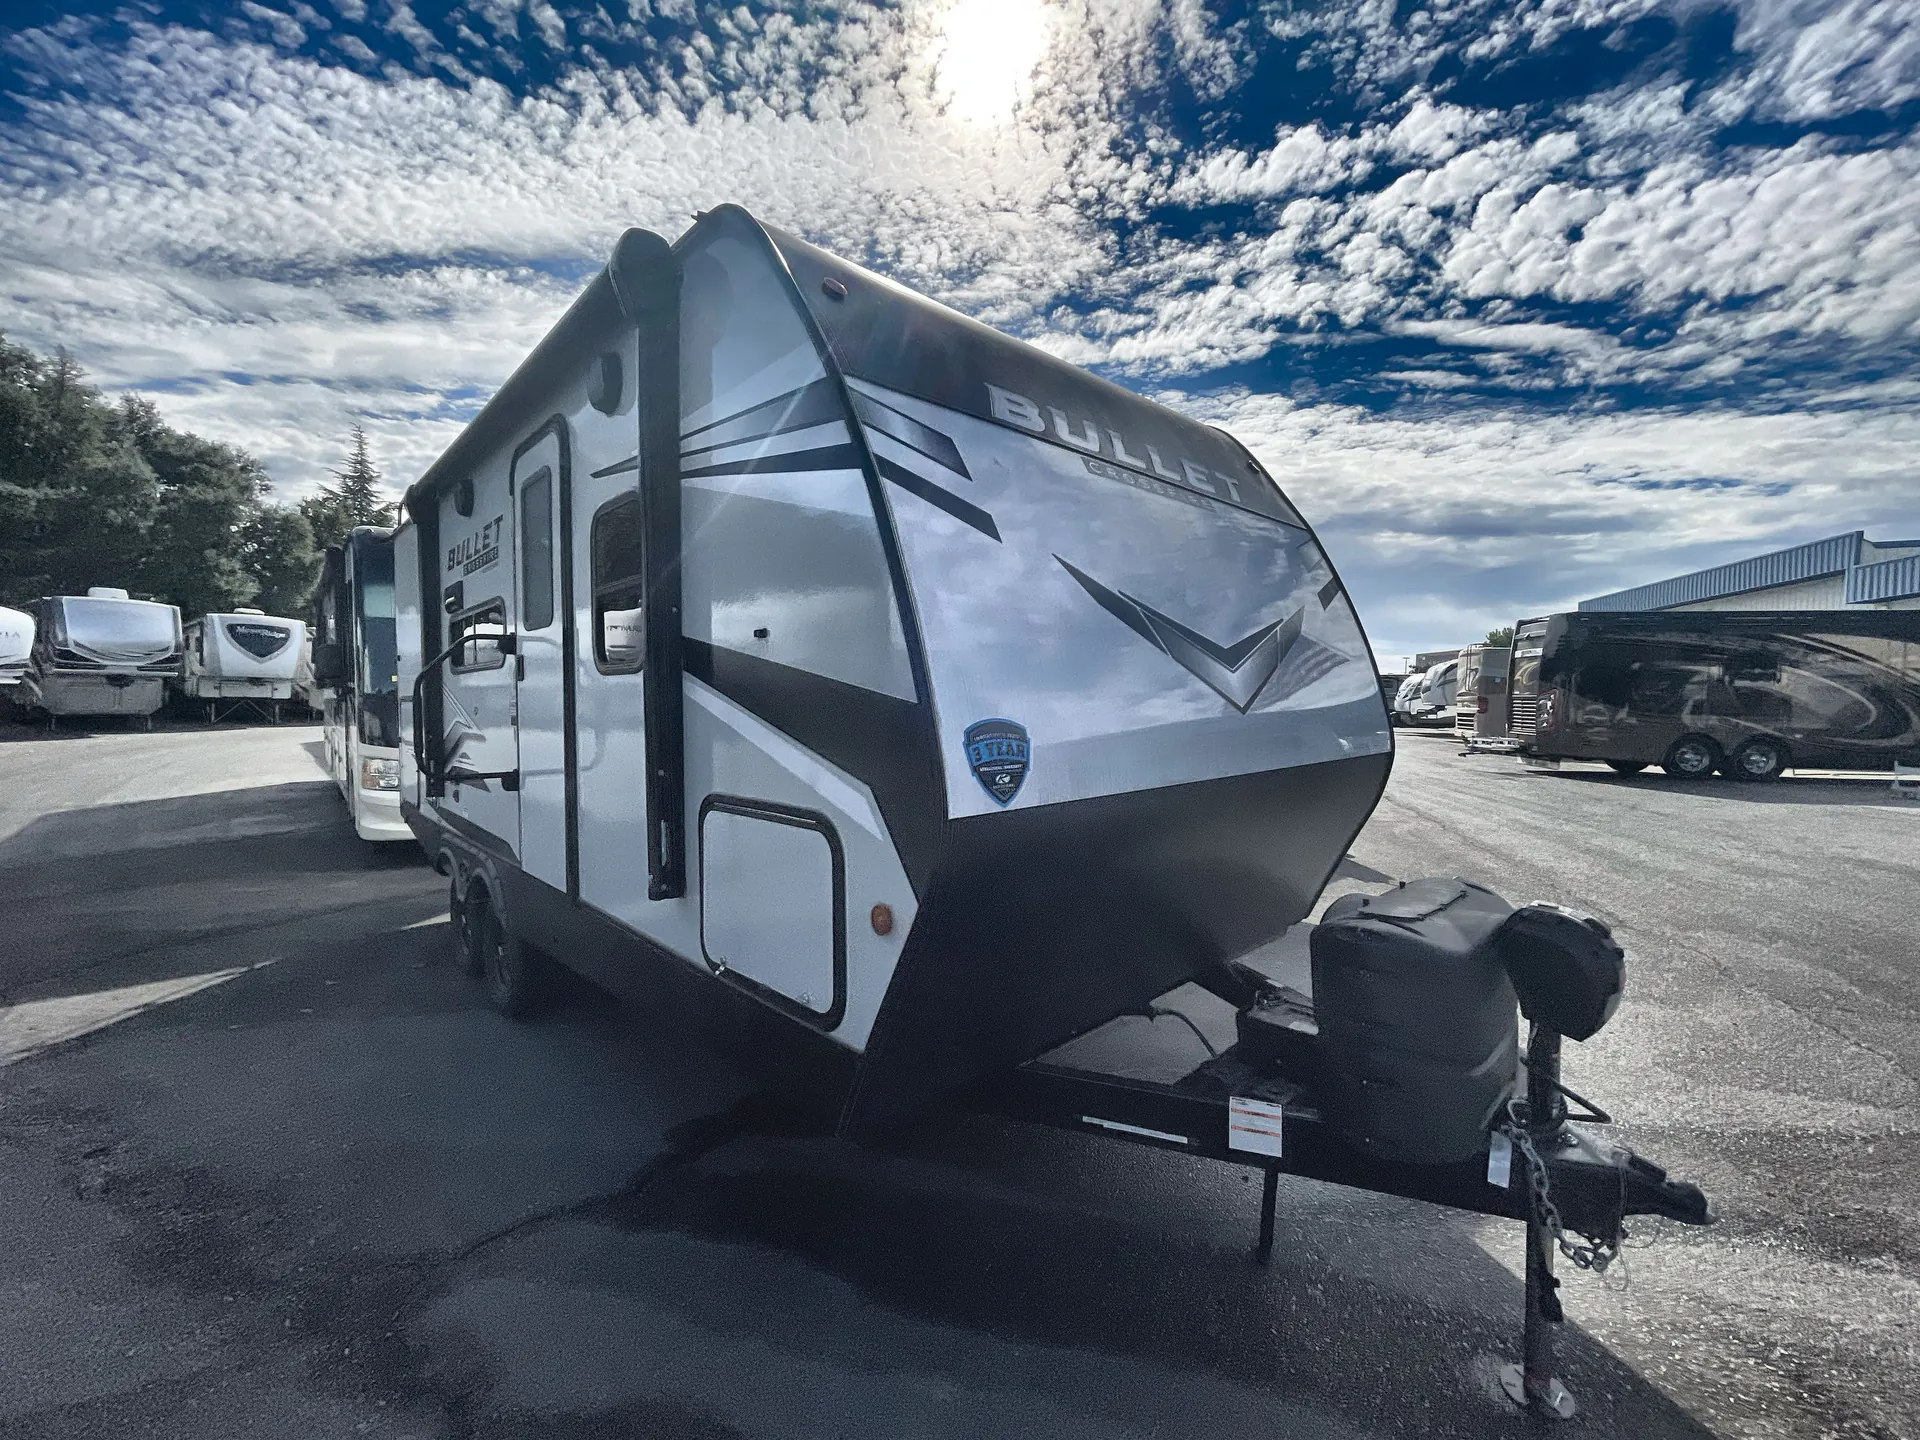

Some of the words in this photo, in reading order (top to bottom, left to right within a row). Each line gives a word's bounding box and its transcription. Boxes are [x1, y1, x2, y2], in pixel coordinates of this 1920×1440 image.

[983, 382, 1241, 502] BULLET
[1088, 460, 1217, 509] CROSSF
[446, 514, 503, 572] BULLET
